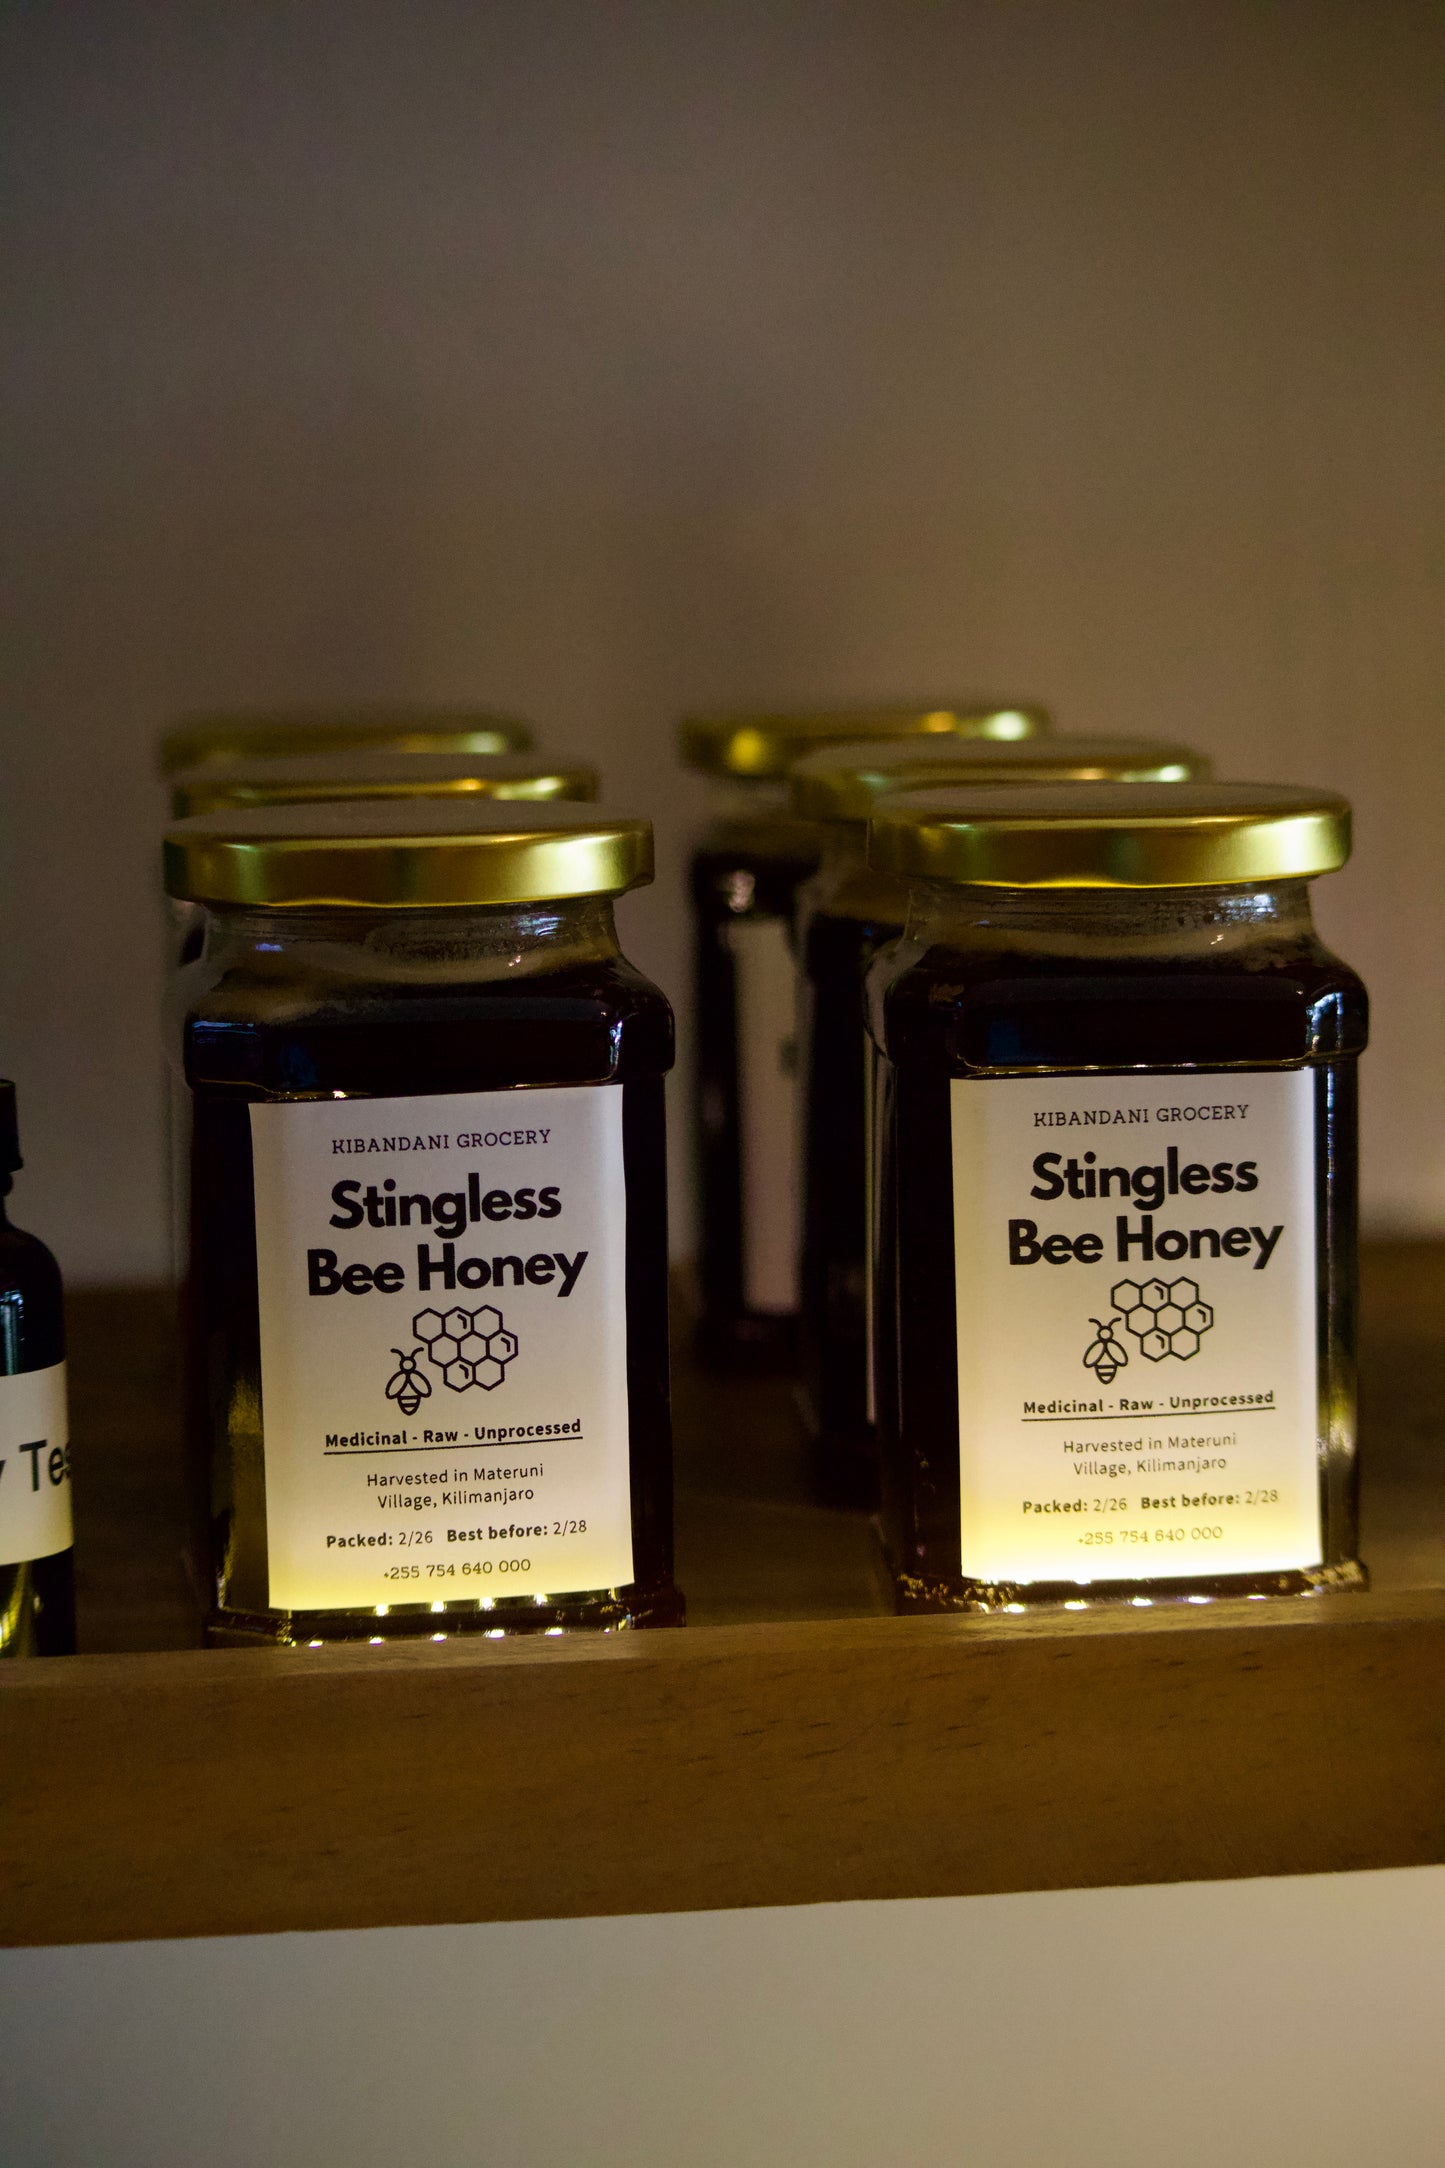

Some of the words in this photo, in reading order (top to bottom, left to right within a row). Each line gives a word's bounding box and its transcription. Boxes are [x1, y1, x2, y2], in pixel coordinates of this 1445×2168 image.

[1033, 1108, 1149, 1127] KIBANDANI
[1156, 1104, 1249, 1123] GROCERY
[332, 1134, 450, 1155] KIBANDANI
[457, 1128, 551, 1149] GROCERY
[1030, 1146, 1259, 1211] Stingless
[329, 1172, 562, 1239] Stingless
[1008, 1218, 1103, 1265] Bee
[1116, 1214, 1284, 1270] Honey
[307, 1248, 405, 1296] Bee
[417, 1242, 589, 1298] Honey
[1023, 1398, 1104, 1415] Medicinal
[1119, 1398, 1153, 1411] Raw
[1170, 1390, 1274, 1411] Unprocessed
[325, 1430, 407, 1448] Medicinal
[423, 1429, 458, 1443] Raw
[474, 1419, 582, 1443] Unprocessed
[1064, 1437, 1143, 1454] Harvested
[1148, 1436, 1163, 1450] in
[1168, 1435, 1236, 1449] Materuni
[367, 1469, 448, 1487] Harvested
[454, 1468, 468, 1482] in
[474, 1466, 544, 1481] Materuni
[1073, 1460, 1132, 1477] Village,
[1137, 1458, 1227, 1473] Kilimanjaro
[377, 1493, 437, 1511] Village,
[442, 1487, 534, 1506] Kilimanjaro
[1022, 1499, 1088, 1514] Packed:
[1093, 1497, 1127, 1513] 2/26
[1141, 1495, 1176, 1509] Best
[1181, 1492, 1239, 1508] before:
[1245, 1489, 1279, 1504] 2/28
[326, 1532, 393, 1549] Packed:
[398, 1530, 433, 1547] 2/26
[447, 1527, 483, 1543] Best
[488, 1523, 548, 1540] before:
[552, 1519, 587, 1536] 2/28
[1120, 1530, 1149, 1543] 754
[1155, 1527, 1185, 1542] 640
[1191, 1526, 1223, 1540] 000
[383, 1565, 420, 1580] +255
[426, 1563, 456, 1578] 754
[462, 1560, 493, 1576] 640
[498, 1558, 531, 1573] 000
